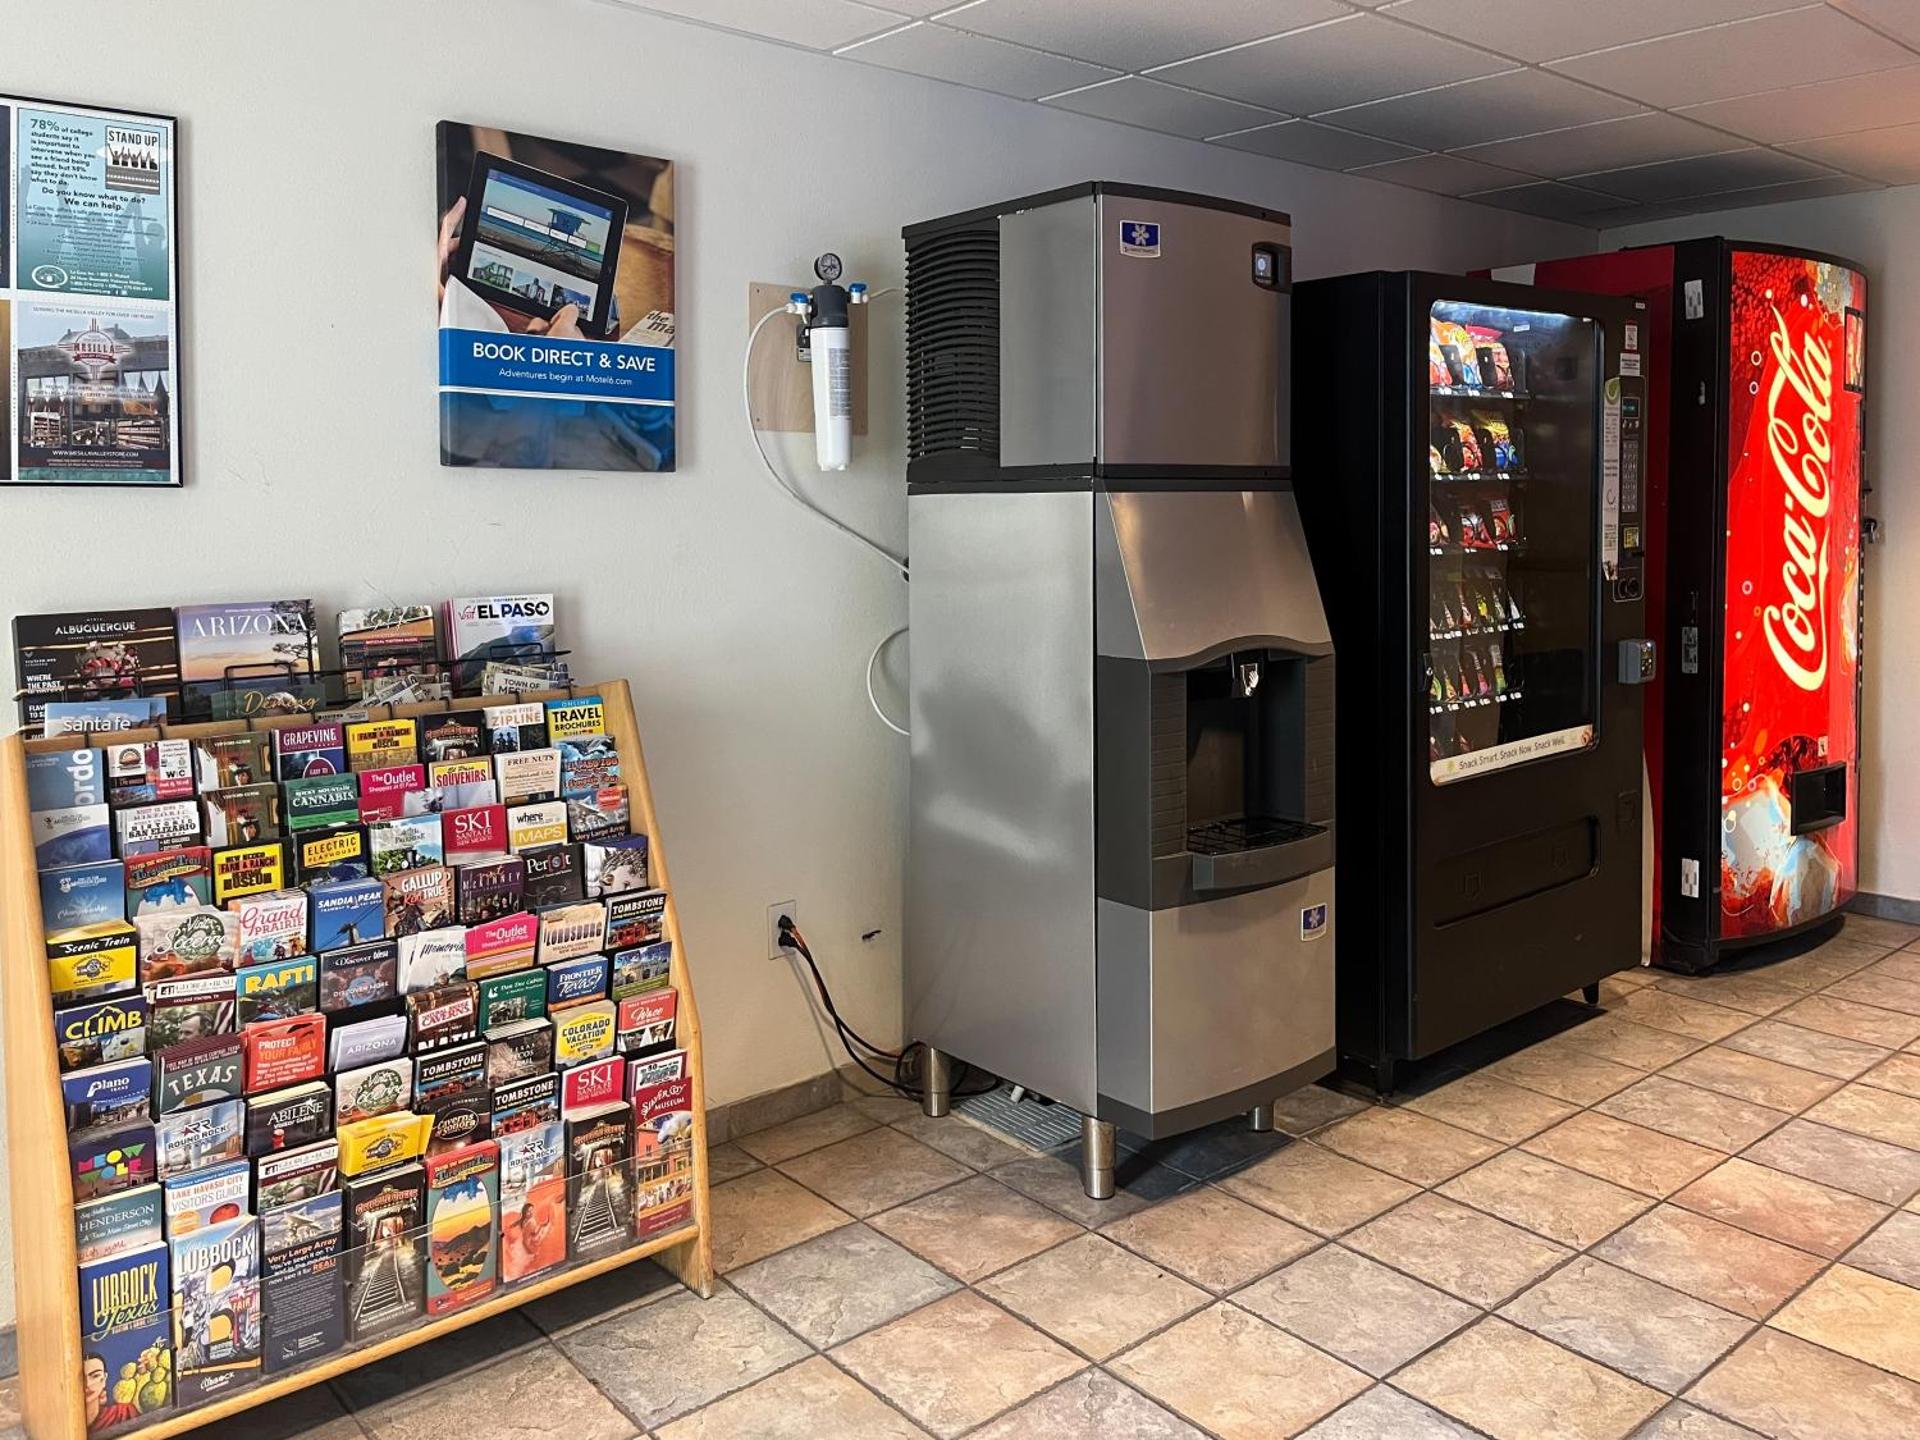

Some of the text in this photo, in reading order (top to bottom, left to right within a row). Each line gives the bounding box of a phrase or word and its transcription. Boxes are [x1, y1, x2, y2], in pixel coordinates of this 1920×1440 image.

[30, 118, 60, 132] 78%
[69, 127, 94, 137] college
[38, 140, 71, 148] important
[108, 130, 158, 147] STAND UP
[71, 158, 90, 167] being
[44, 170, 59, 178] they
[41, 186, 54, 194] Do
[73, 190, 96, 199] know
[97, 192, 118, 202] what
[119, 194, 129, 202] to
[130, 196, 146, 204] do?
[63, 197, 125, 211] We can help.
[646, 310, 669, 325] the
[74, 343, 115, 354] MESILLA
[472, 341, 657, 372] BOOK DIRECT & SAVE
[498, 367, 633, 387] Adventures begin at Motel6.com
[1763, 303, 1832, 692] Coca-Cola
[477, 601, 550, 620] EL PASO
[55, 621, 136, 636] ALBUQUERQUE
[192, 613, 308, 638] ARIZONA
[26, 674, 52, 682] WHERE
[27, 680, 61, 690] THE PAST
[504, 679, 528, 688] TOWN
[63, 716, 132, 732] santa fe
[491, 712, 541, 727] ZIPLINE
[552, 707, 602, 723] TRAVEL
[358, 730, 377, 741] FARM
[385, 727, 411, 737] RANCH
[554, 719, 601, 732] BROCHURES
[283, 728, 337, 746] GRAPEVINE
[507, 754, 554, 766] FREE NUTS
[1459, 741, 1551, 770] Snack Snack Snack
[383, 771, 417, 785] Outlet
[436, 769, 486, 787] SOUVENIRS
[292, 791, 355, 807] CANNABIS
[454, 810, 492, 834] SKI
[516, 811, 544, 823] where
[128, 823, 196, 839] SAN ELIZARIO
[456, 829, 481, 841] SANTA
[519, 826, 562, 843] MAPS
[575, 829, 608, 841] Very Large
[307, 837, 357, 856] ELECTRIC
[308, 847, 357, 863] PLAYHOUSE
[220, 856, 276, 874] FARM & RANCH
[223, 873, 272, 891] MUSEUM
[401, 871, 442, 893] GALLUP
[317, 896, 353, 909] SANDIA
[357, 891, 382, 901] PEAK
[422, 887, 445, 900] TRUE
[613, 896, 665, 914] TOMBSTONE
[240, 901, 304, 937] Grand
[255, 917, 304, 935] PRAIRIE
[496, 924, 528, 940] Outlet
[545, 921, 602, 946] LORDSBURG
[59, 937, 130, 954] Scenic Train
[246, 965, 314, 993] RAFT!
[559, 966, 603, 982] FRONTIER
[557, 974, 603, 998] Texas!
[65, 1010, 142, 1039] CLIMB
[422, 1005, 470, 1026] CAVERNS
[562, 1018, 611, 1037] COLORADO
[566, 1028, 606, 1044] VACATION
[259, 1037, 296, 1049] PROTECT
[259, 1039, 317, 1061] YOUR FAMILY
[347, 1039, 397, 1055] ARIZONA
[422, 1053, 484, 1077] TOMBSTONE
[168, 1065, 238, 1097] TEXAS
[577, 1064, 613, 1090] SKI
[87, 1076, 130, 1098] Plano
[495, 1080, 554, 1106] TOMBSTONE
[642, 1084, 686, 1110] SILVER CITY
[654, 1097, 685, 1110] MUSEUM
[267, 1102, 324, 1126] ABILENE
[437, 1113, 474, 1130] Caverns
[168, 1125, 226, 1150] ROUND ROCK
[78, 1143, 147, 1173] MEOW
[510, 1147, 555, 1167] ROUND ROCK
[79, 1158, 143, 1182] WOLF
[171, 1189, 192, 1199] LAKE
[193, 1180, 225, 1194] HAVASU
[226, 1176, 244, 1186] CITY
[171, 1184, 244, 1211] VISITORS GUIDE
[79, 1204, 155, 1233] HENDERSON
[178, 1235, 253, 1277] LUBBOCK
[267, 1237, 338, 1264] Very Large Array
[270, 1261, 292, 1271] You've
[293, 1255, 309, 1264] seen
[325, 1245, 334, 1253] TV
[268, 1277, 284, 1285] now
[303, 1267, 312, 1276] for
[312, 1258, 337, 1273] REAL!
[92, 1262, 158, 1321] LUBBOCK
[91, 1300, 160, 1342] Texas
